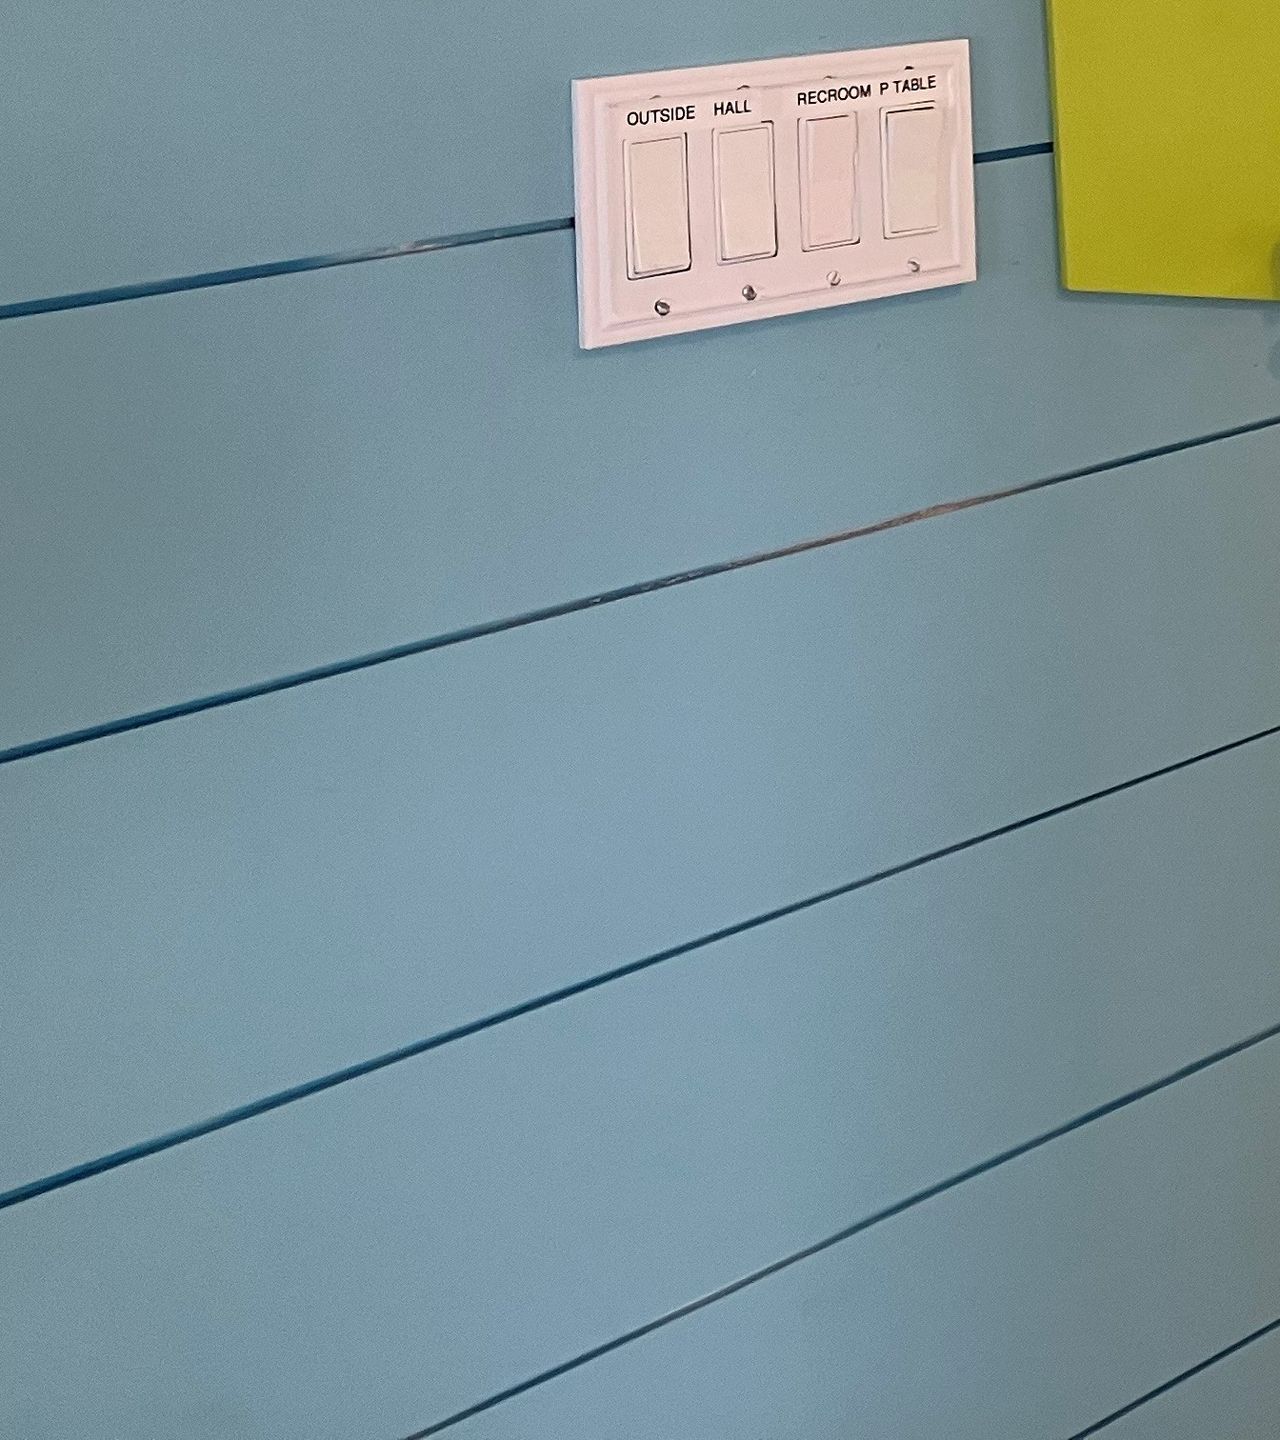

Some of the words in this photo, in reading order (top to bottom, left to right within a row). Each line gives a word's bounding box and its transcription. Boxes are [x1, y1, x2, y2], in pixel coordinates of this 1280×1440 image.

[797, 84, 872, 106] RECROOM
[879, 82, 889, 96] P
[893, 74, 937, 94] TABLE
[626, 105, 696, 127] OUTSIDE
[713, 99, 752, 116] HALL
